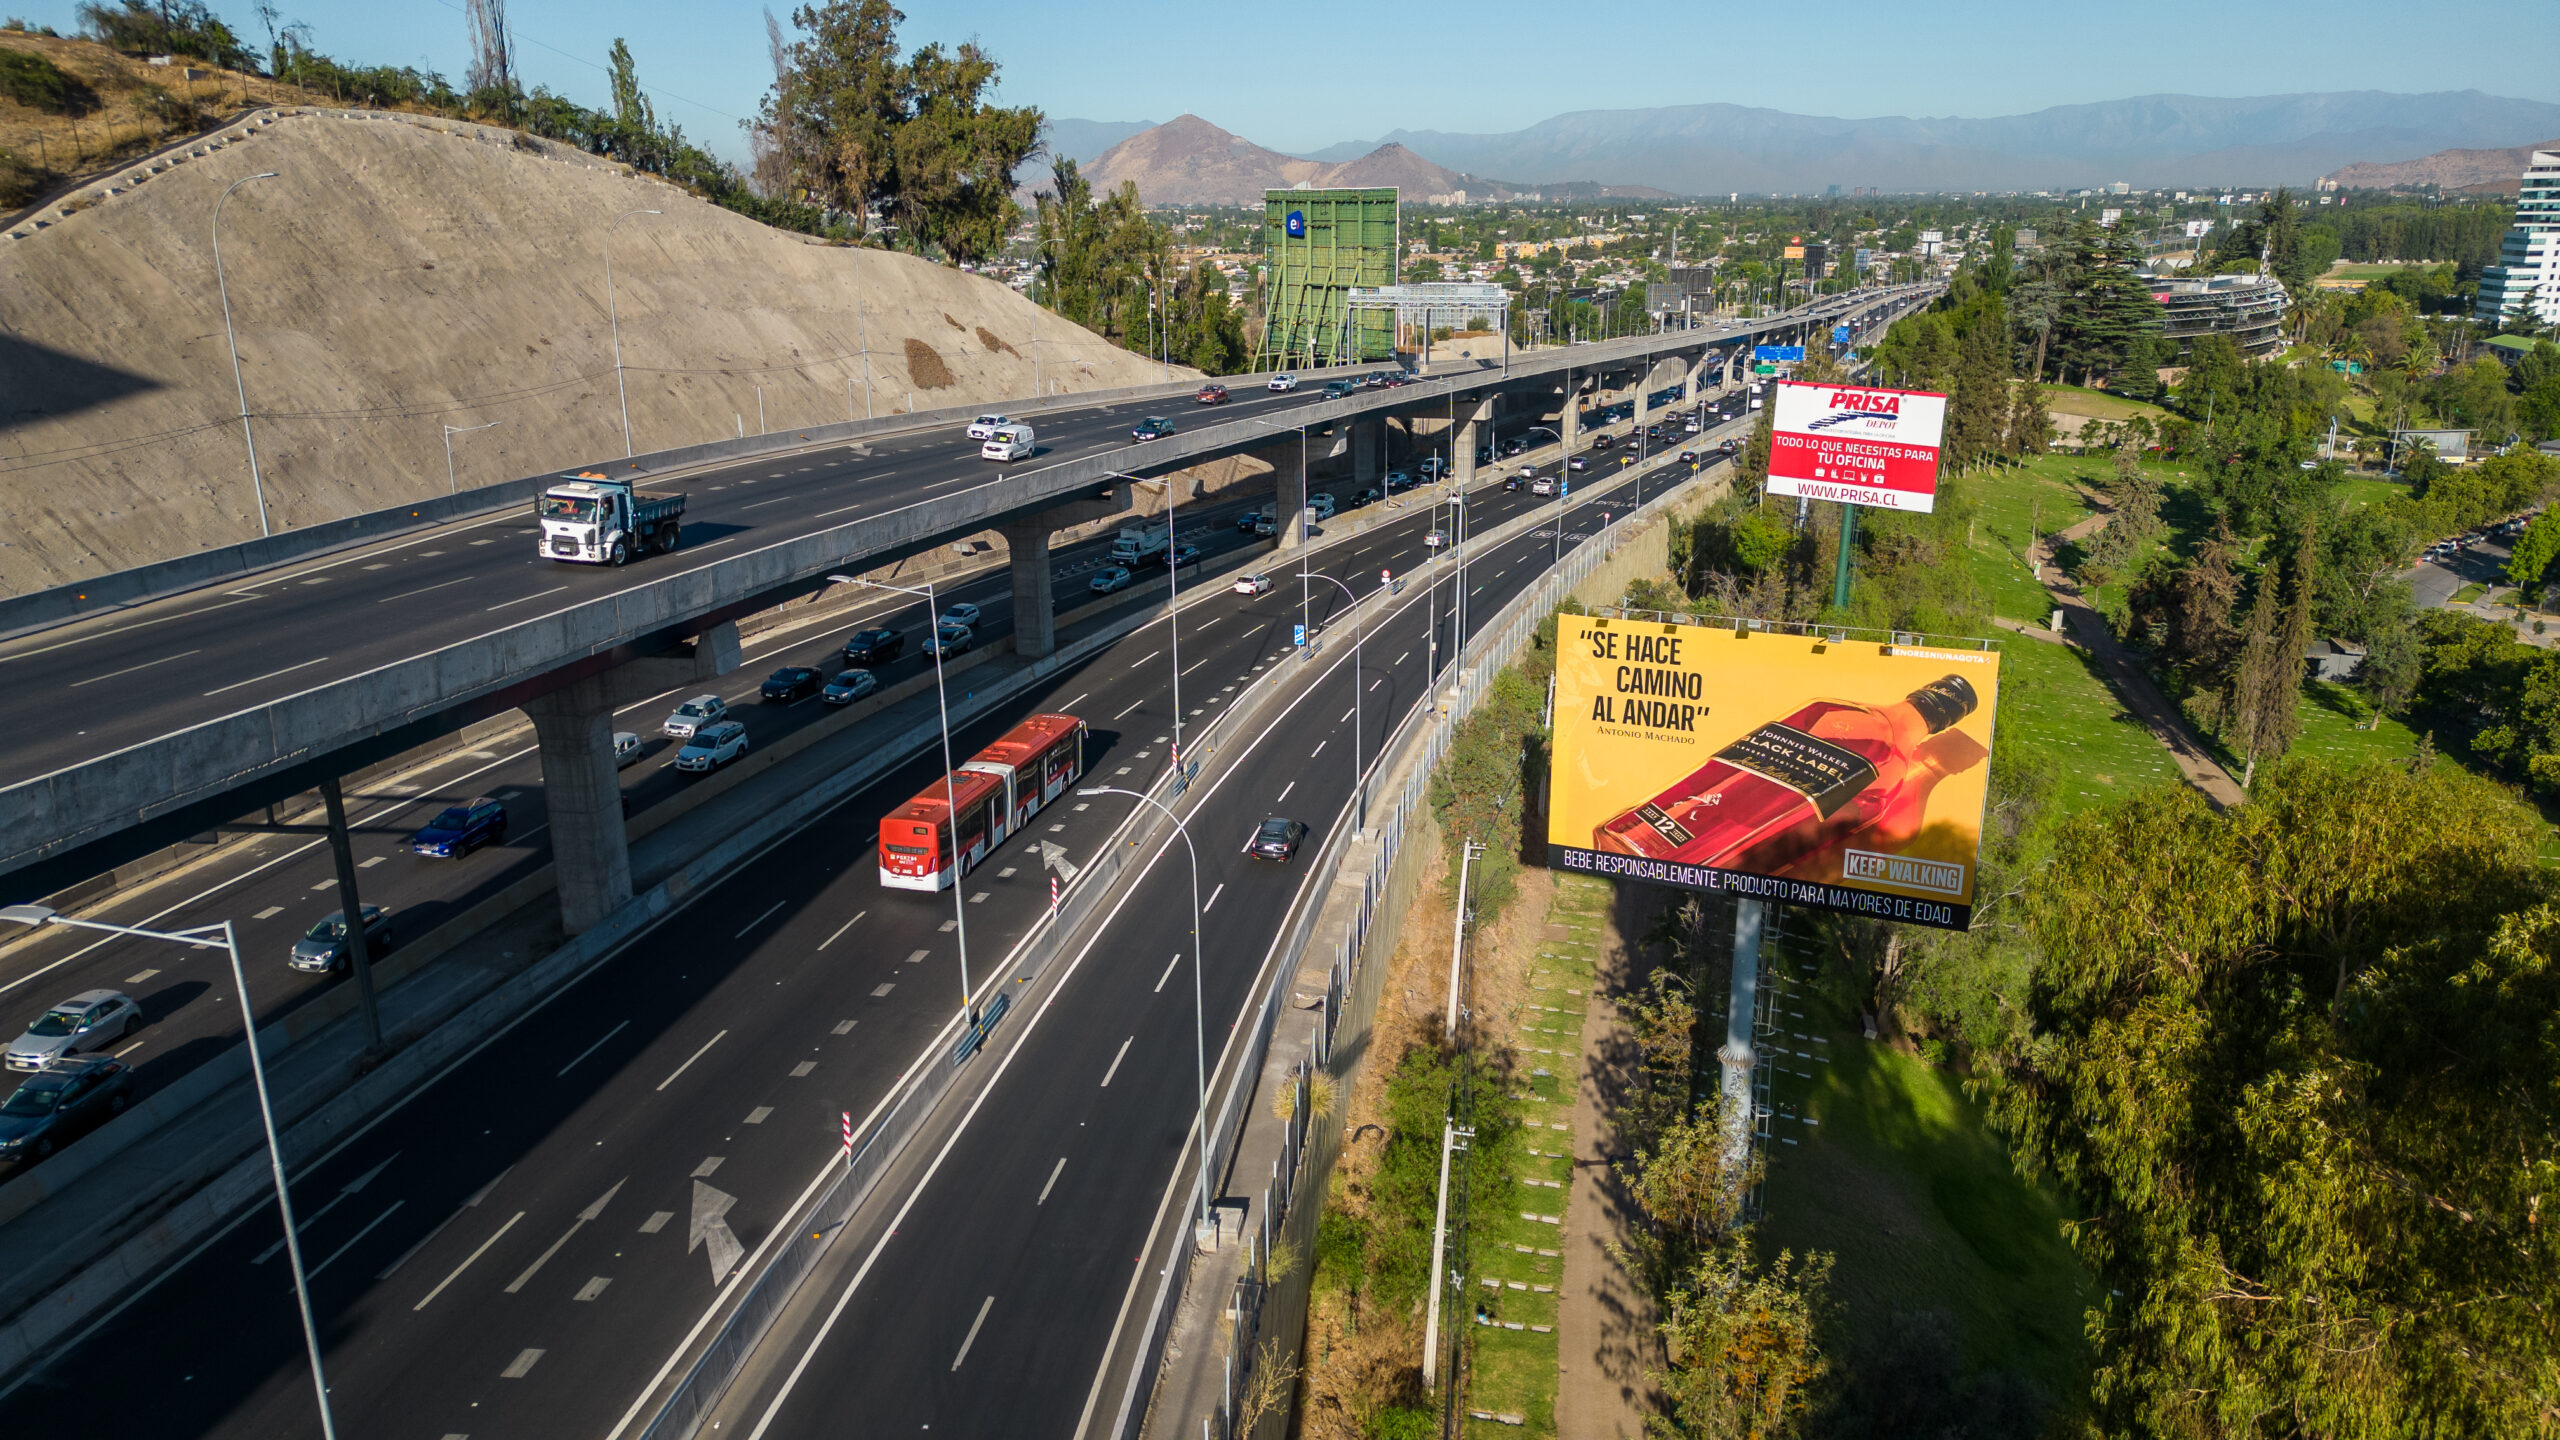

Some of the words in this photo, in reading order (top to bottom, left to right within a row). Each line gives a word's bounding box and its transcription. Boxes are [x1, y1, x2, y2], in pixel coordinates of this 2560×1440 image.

[1829, 392, 1900, 414] PRISA
[1865, 419, 1897, 430] DEPOT
[1776, 436, 1804, 448] TODO
[1806, 438, 1818, 450] LO
[1821, 440, 1843, 452] QUE
[1845, 443, 1902, 458] NECESITAS
[1904, 449, 1934, 462] PARA
[1818, 452, 1834, 464] TU
[1836, 454, 1886, 470] OFICINA
[1797, 482, 1898, 507] WWW.PRISA.CL
[1626, 634, 1682, 666] HACE
[1616, 666, 1702, 700] CAMINO
[1592, 695, 1616, 723] AL
[1759, 730, 1806, 751] JOHNNIE
[1807, 746, 1848, 770] WALKER
[1796, 754, 1845, 784] LABEL
[1654, 816, 1676, 834] 12
[1848, 854, 1886, 878] KEEP
[1888, 860, 1958, 890] WALKING
[1564, 850, 1593, 870] BEBE
[1596, 854, 1721, 889] RESPONSABLEMENTE.
[1724, 873, 1788, 898] PRODUCTO
[1791, 883, 1826, 905] PARA
[1829, 888, 1891, 916] MAYORES
[1895, 898, 1911, 918] DE
[1915, 902, 1954, 926] EDAD.
